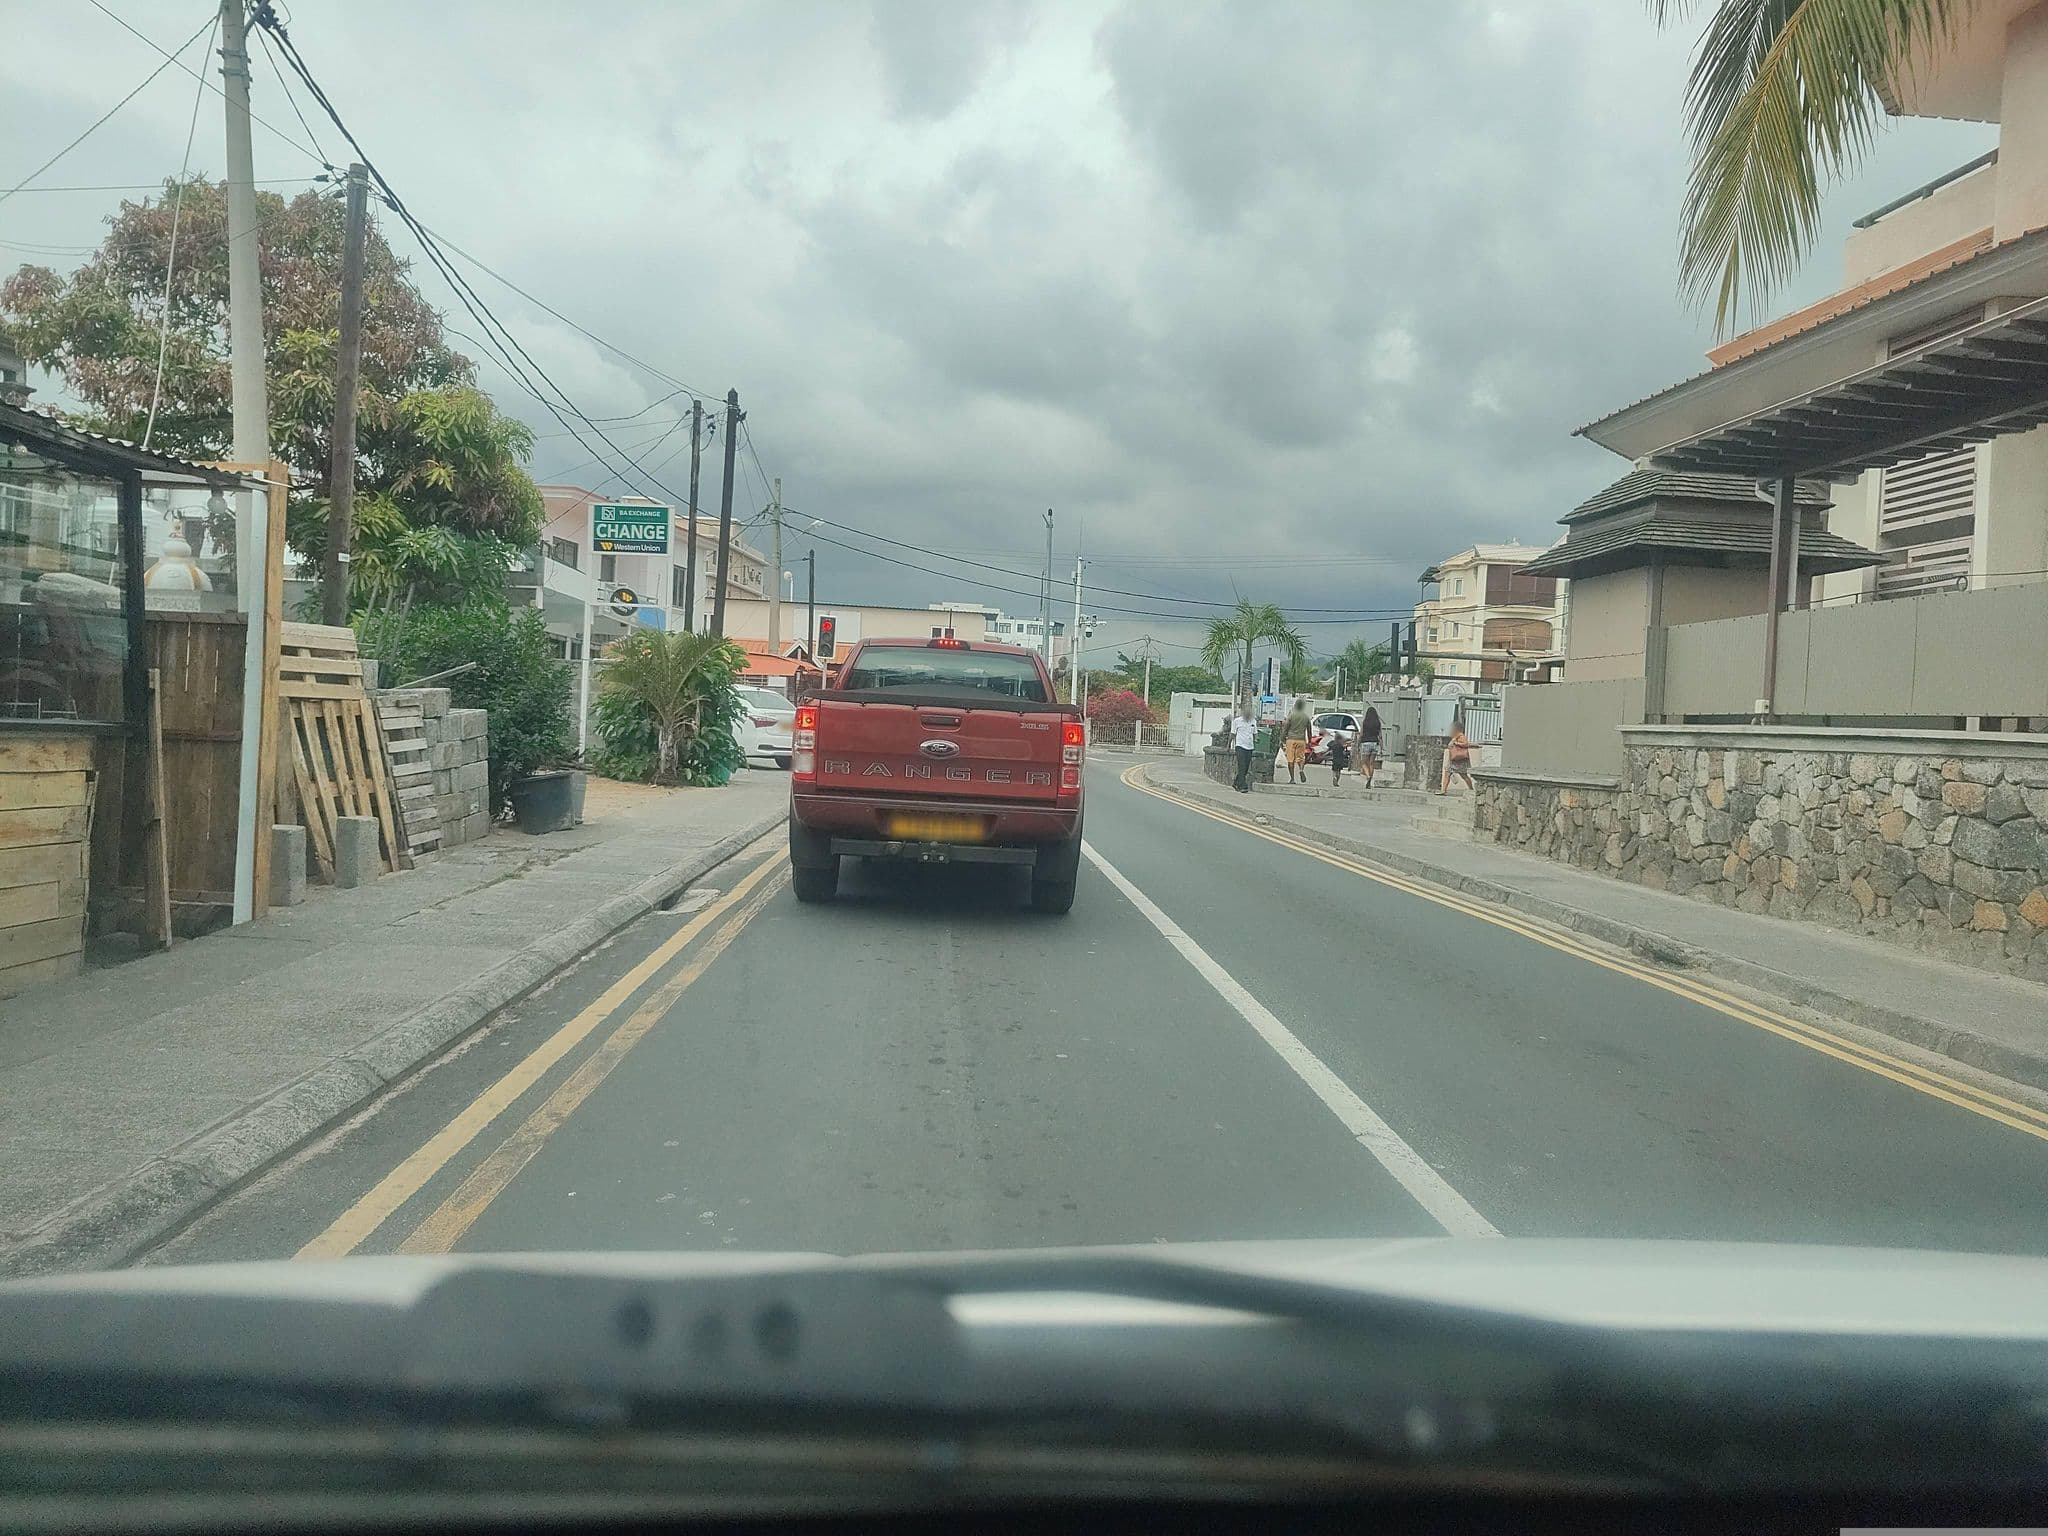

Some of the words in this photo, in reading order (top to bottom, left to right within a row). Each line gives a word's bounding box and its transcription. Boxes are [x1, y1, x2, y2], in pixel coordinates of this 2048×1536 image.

[596, 523, 666, 540] CHANGE
[613, 543, 641, 551] Western
[641, 544, 661, 552] Union
[824, 759, 1051, 786] RANGER
